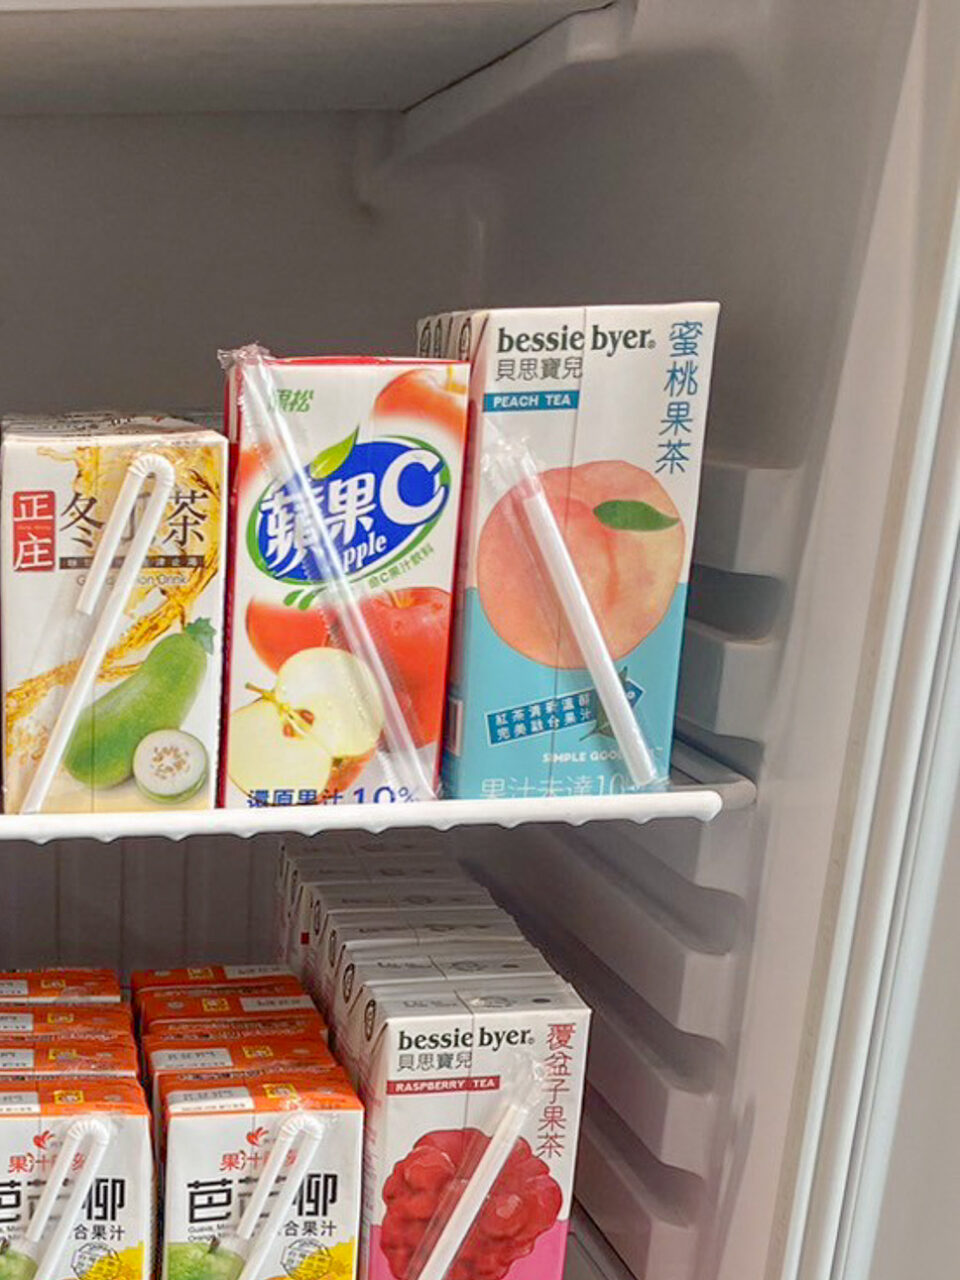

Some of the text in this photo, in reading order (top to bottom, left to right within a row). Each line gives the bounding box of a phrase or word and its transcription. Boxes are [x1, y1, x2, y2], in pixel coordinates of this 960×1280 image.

[497, 321, 652, 358] bessie byer
[494, 356, 584, 382] 貝思寶兒
[493, 393, 572, 409] PEACH TEA
[655, 320, 704, 475] 蜜桃果茶
[13, 493, 54, 572] 正庄
[338, 529, 388, 574] pple
[480, 775, 630, 799] 果汁未達10
[397, 1026, 531, 1054] bessie byer
[396, 1052, 473, 1072] 貝思寶兒
[395, 1078, 495, 1093] RASPBERRY TEA
[537, 1022, 577, 1159] 覆盆子果茶
[8, 1154, 86, 1174] 果汁
[219, 1150, 298, 1172] 果汁
[71, 1224, 126, 1242] 合果汁
[281, 1220, 338, 1238] 合果汁
